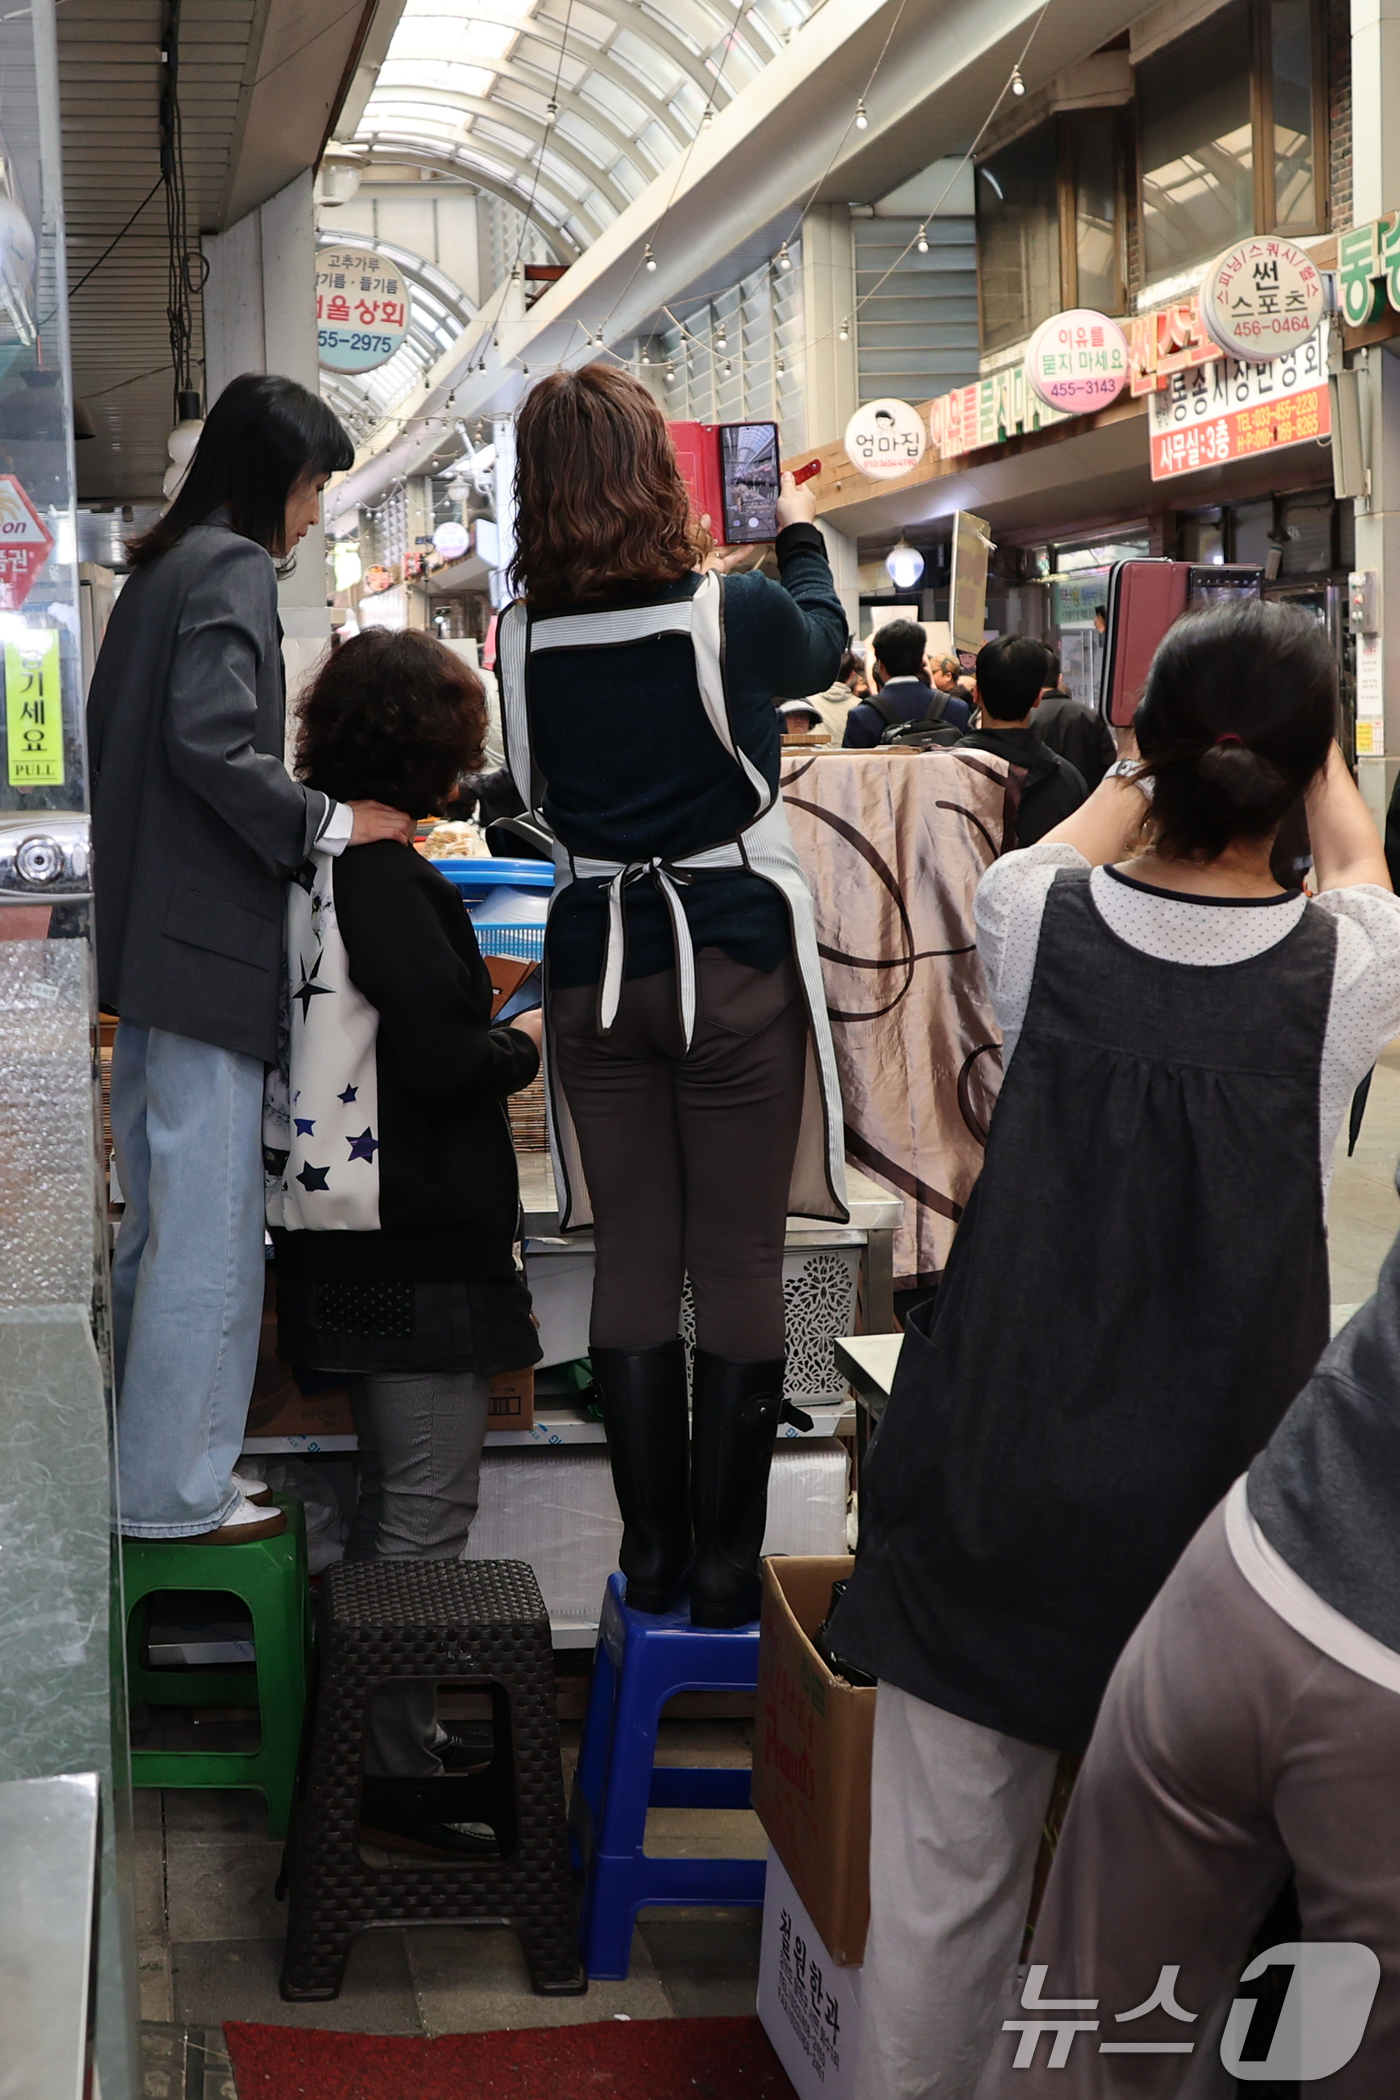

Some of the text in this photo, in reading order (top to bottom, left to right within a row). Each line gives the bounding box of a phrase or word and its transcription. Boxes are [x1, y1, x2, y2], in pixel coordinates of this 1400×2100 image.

[328, 254, 380, 272] 고추가루
[360, 276, 398, 294] 들기름
[1252, 260, 1280, 291] 썬
[1231, 290, 1308, 318] 스포츠
[1233, 315, 1310, 337] 456-0464
[1058, 326, 1104, 349] 이유를
[1051, 379, 1116, 397] 455-3143
[856, 432, 919, 457] 엄마집
[15, 765, 54, 777] PULL
[780, 1908, 840, 2046] 철원한과
